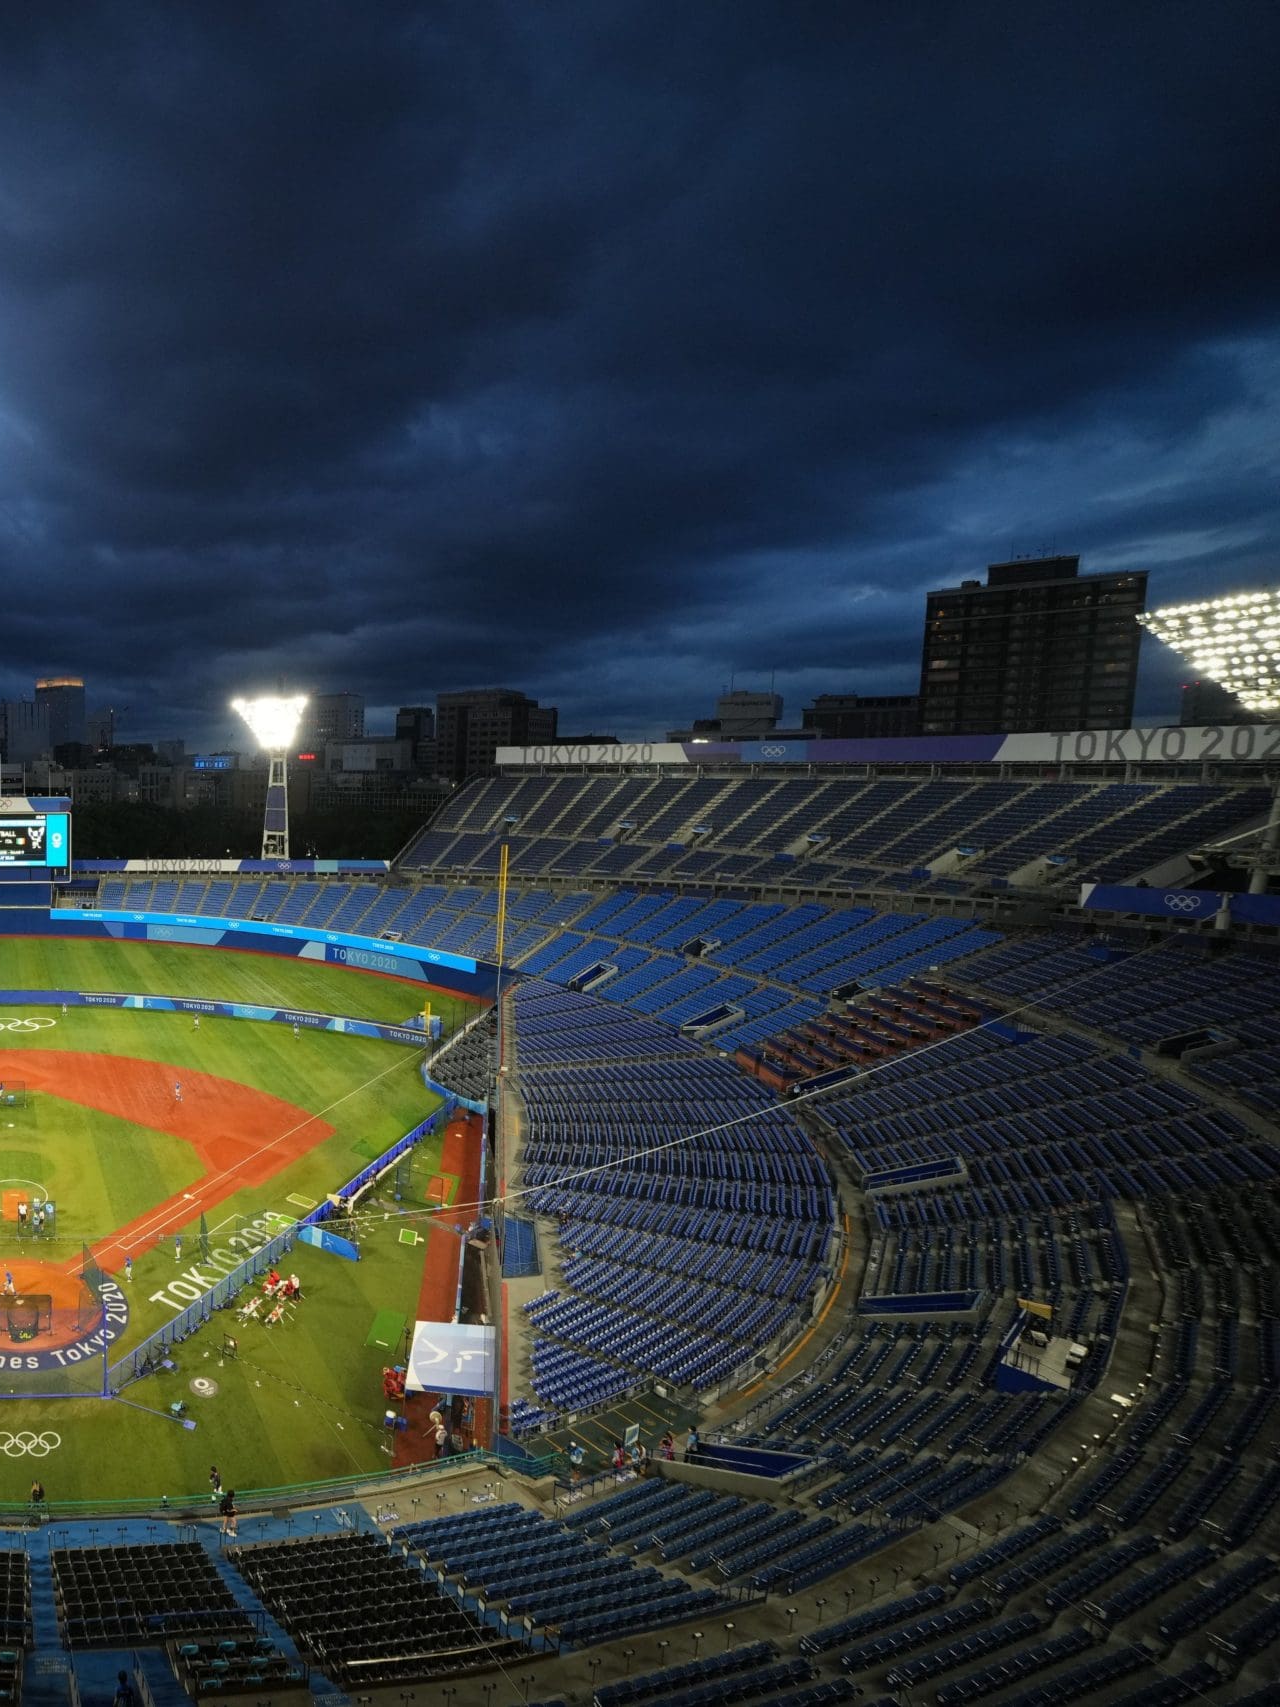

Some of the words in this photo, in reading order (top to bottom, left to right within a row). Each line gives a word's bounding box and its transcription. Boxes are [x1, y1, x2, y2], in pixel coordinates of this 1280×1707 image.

[520, 744, 590, 763] TOKYO
[596, 743, 653, 763] 2020
[1051, 727, 1186, 760] TOKYO
[144, 859, 187, 871] TOKYO
[189, 859, 222, 871] 2020
[333, 948, 369, 964] TOKYO
[370, 954, 397, 970] 2020
[183, 1002, 201, 1010] TOKYO
[201, 1003, 215, 1011] 2020
[285, 1013, 304, 1022] TOKYO
[304, 1016, 319, 1024] 2020
[389, 1030, 410, 1041] TOKYO
[410, 1034, 427, 1043] 2020
[149, 1248, 245, 1312] TOKYO
[50, 1329, 116, 1367] Tokyo
[98, 1282, 128, 1324] 2020
